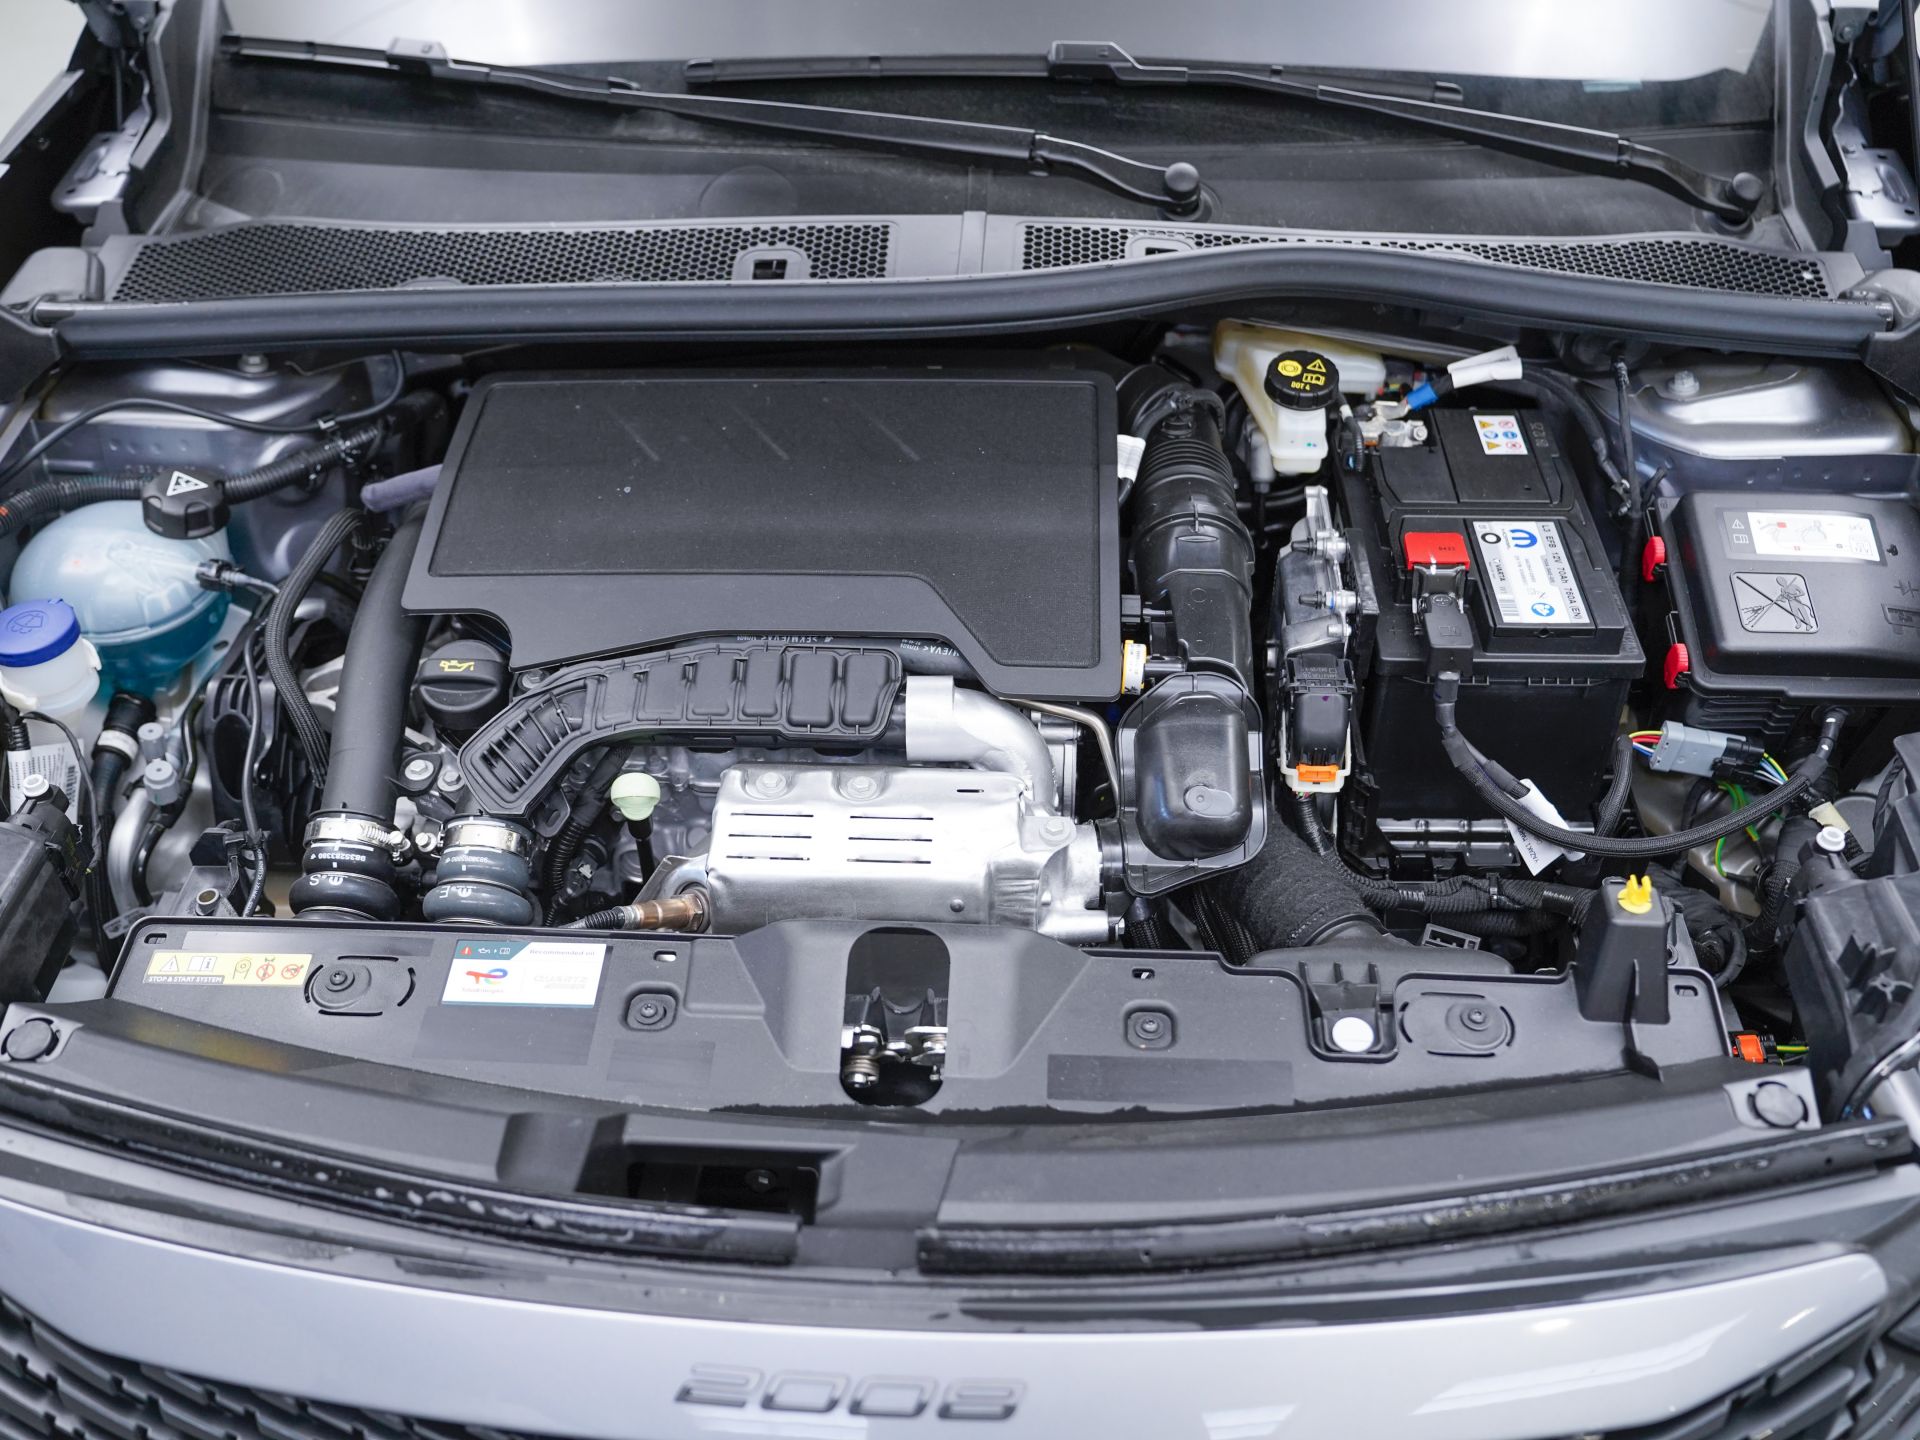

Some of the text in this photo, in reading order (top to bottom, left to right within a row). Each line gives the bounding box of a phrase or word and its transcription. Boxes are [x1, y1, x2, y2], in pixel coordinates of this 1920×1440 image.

[1290, 381, 1311, 391] DOT 4
[1545, 535, 1557, 549] EFB
[1552, 552, 1563, 565] 12V
[1557, 567, 1569, 584] 70Ah
[148, 975, 167, 983] STOP
[195, 976, 223, 984] SYSTEM
[673, 1361, 1028, 1421] 2008
